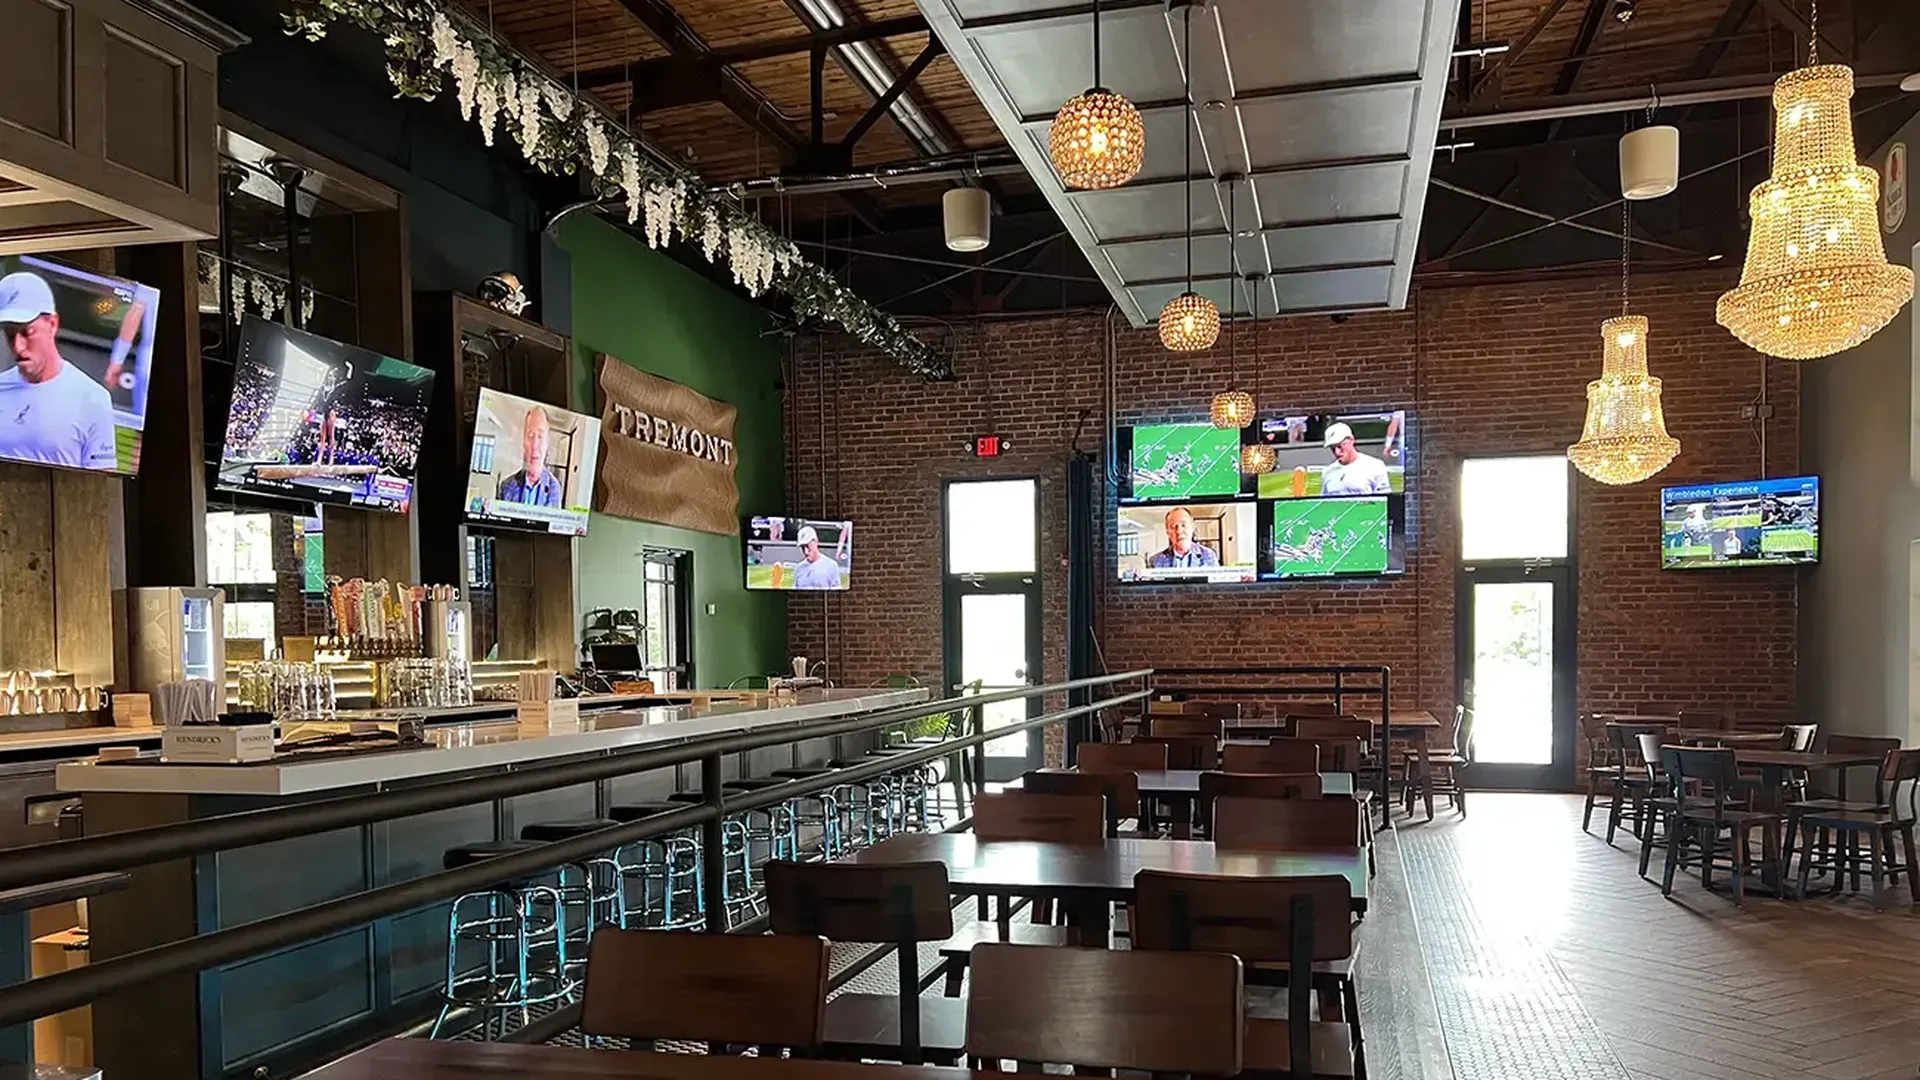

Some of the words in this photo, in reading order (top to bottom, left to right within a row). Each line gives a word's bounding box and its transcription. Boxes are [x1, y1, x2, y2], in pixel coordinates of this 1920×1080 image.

[615, 403, 733, 465] TREMONT
[977, 437, 998, 455] EXIT
[1665, 488, 1711, 499] Wimbledon
[1713, 485, 1759, 497] Experience
